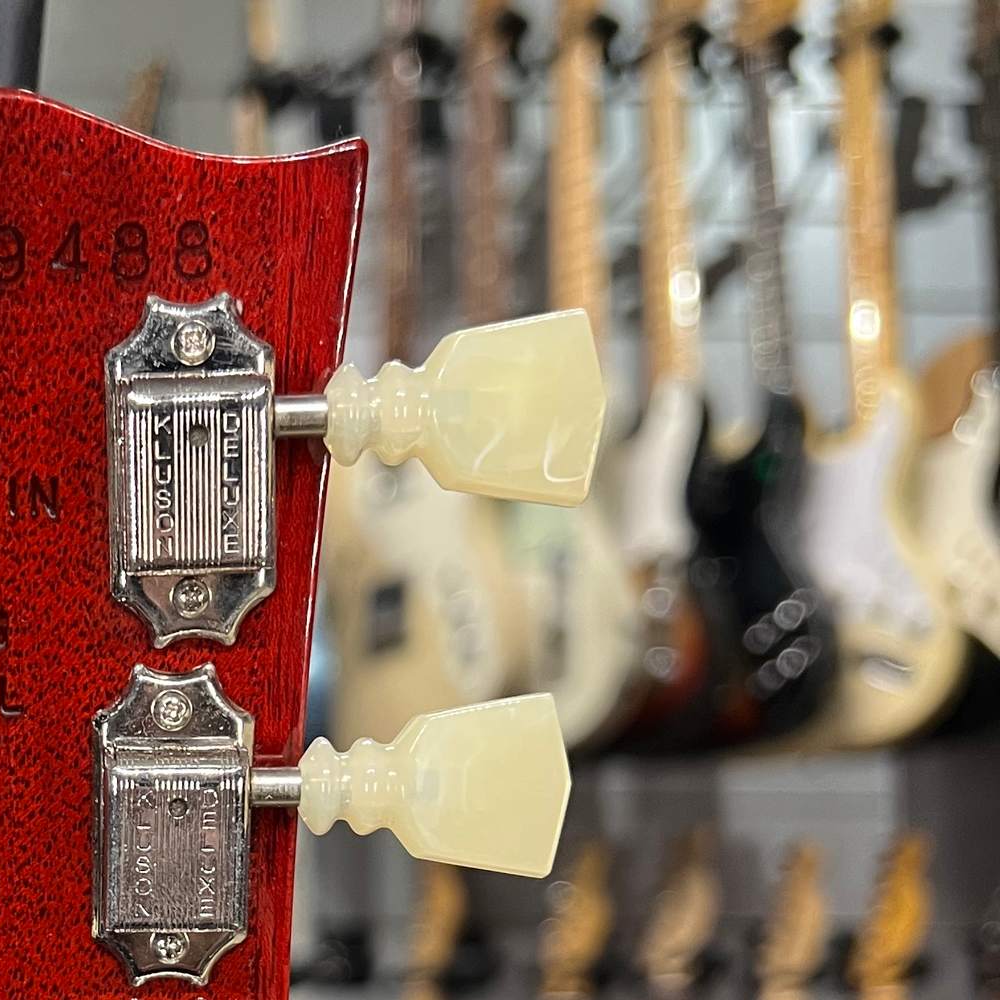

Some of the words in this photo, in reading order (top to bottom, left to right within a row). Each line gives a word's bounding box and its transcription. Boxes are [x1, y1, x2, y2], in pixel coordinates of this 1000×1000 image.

[8, 473, 59, 519] IN
[154, 415, 174, 557] KLUSON
[222, 412, 241, 554] DELUXE
[135, 790, 153, 917] KLUSON
[199, 789, 218, 918] DELUXE
